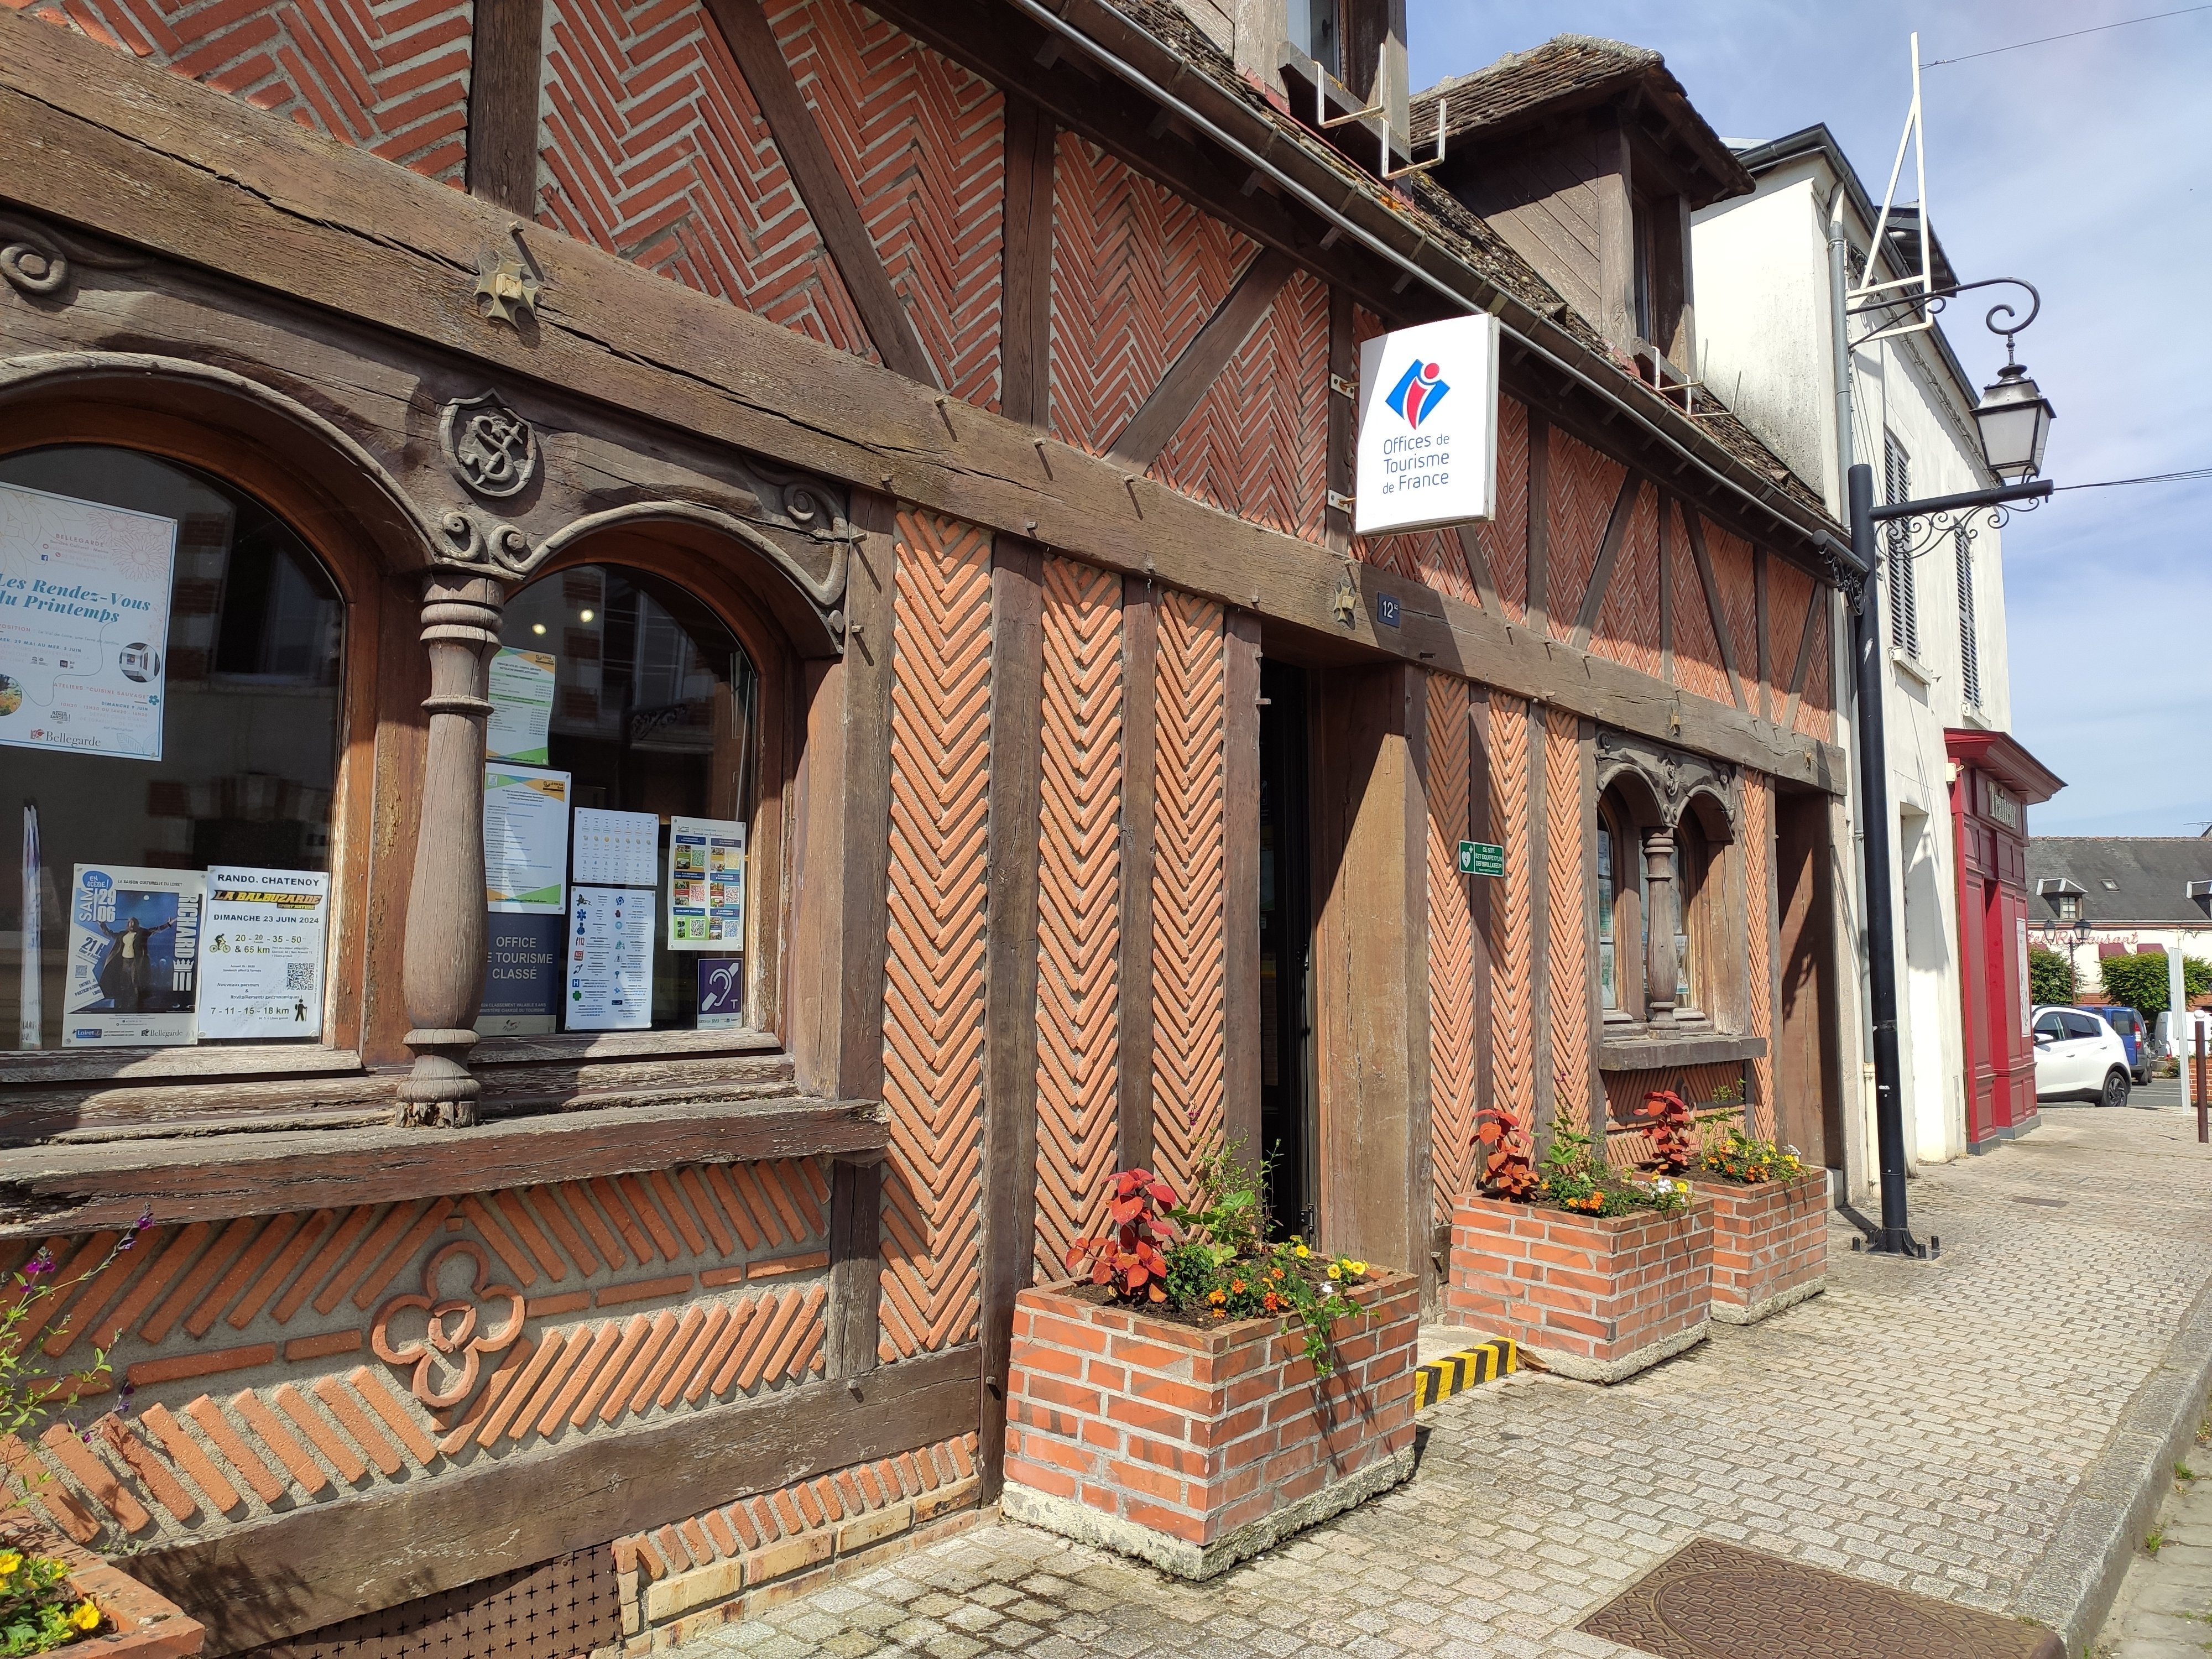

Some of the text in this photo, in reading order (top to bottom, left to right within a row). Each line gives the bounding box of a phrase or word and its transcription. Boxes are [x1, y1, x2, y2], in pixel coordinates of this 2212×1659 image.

[1384, 433, 1450, 455] Offices de
[1384, 452, 1450, 474] Tourisme
[1383, 471, 1449, 494] de France
[56, 533, 105, 547] BELLEGARDE
[31, 579, 151, 611] Rendez-Vous
[22, 594, 120, 623] Printemps
[0, 623, 30, 632] OSITION
[53, 682, 84, 691] ATELIERS
[45, 731, 101, 747] Bellegarde
[262, 876, 320, 886] CHATENOY
[97, 889, 117, 905] 29
[213, 891, 322, 905] LA BALBUZARDE
[79, 887, 94, 922] SAM
[97, 906, 116, 922] 06
[174, 893, 199, 959] RICHARD
[81, 936, 98, 952] 21
[496, 936, 536, 948] OFFICE
[257, 946, 270, 954] km
[487, 952, 553, 964] E TOURISME
[492, 966, 537, 979] CLASSÉ
[225, 1006, 234, 1015] 11
[730, 999, 738, 1009] T
[150, 1029, 183, 1038] Bellegarde
